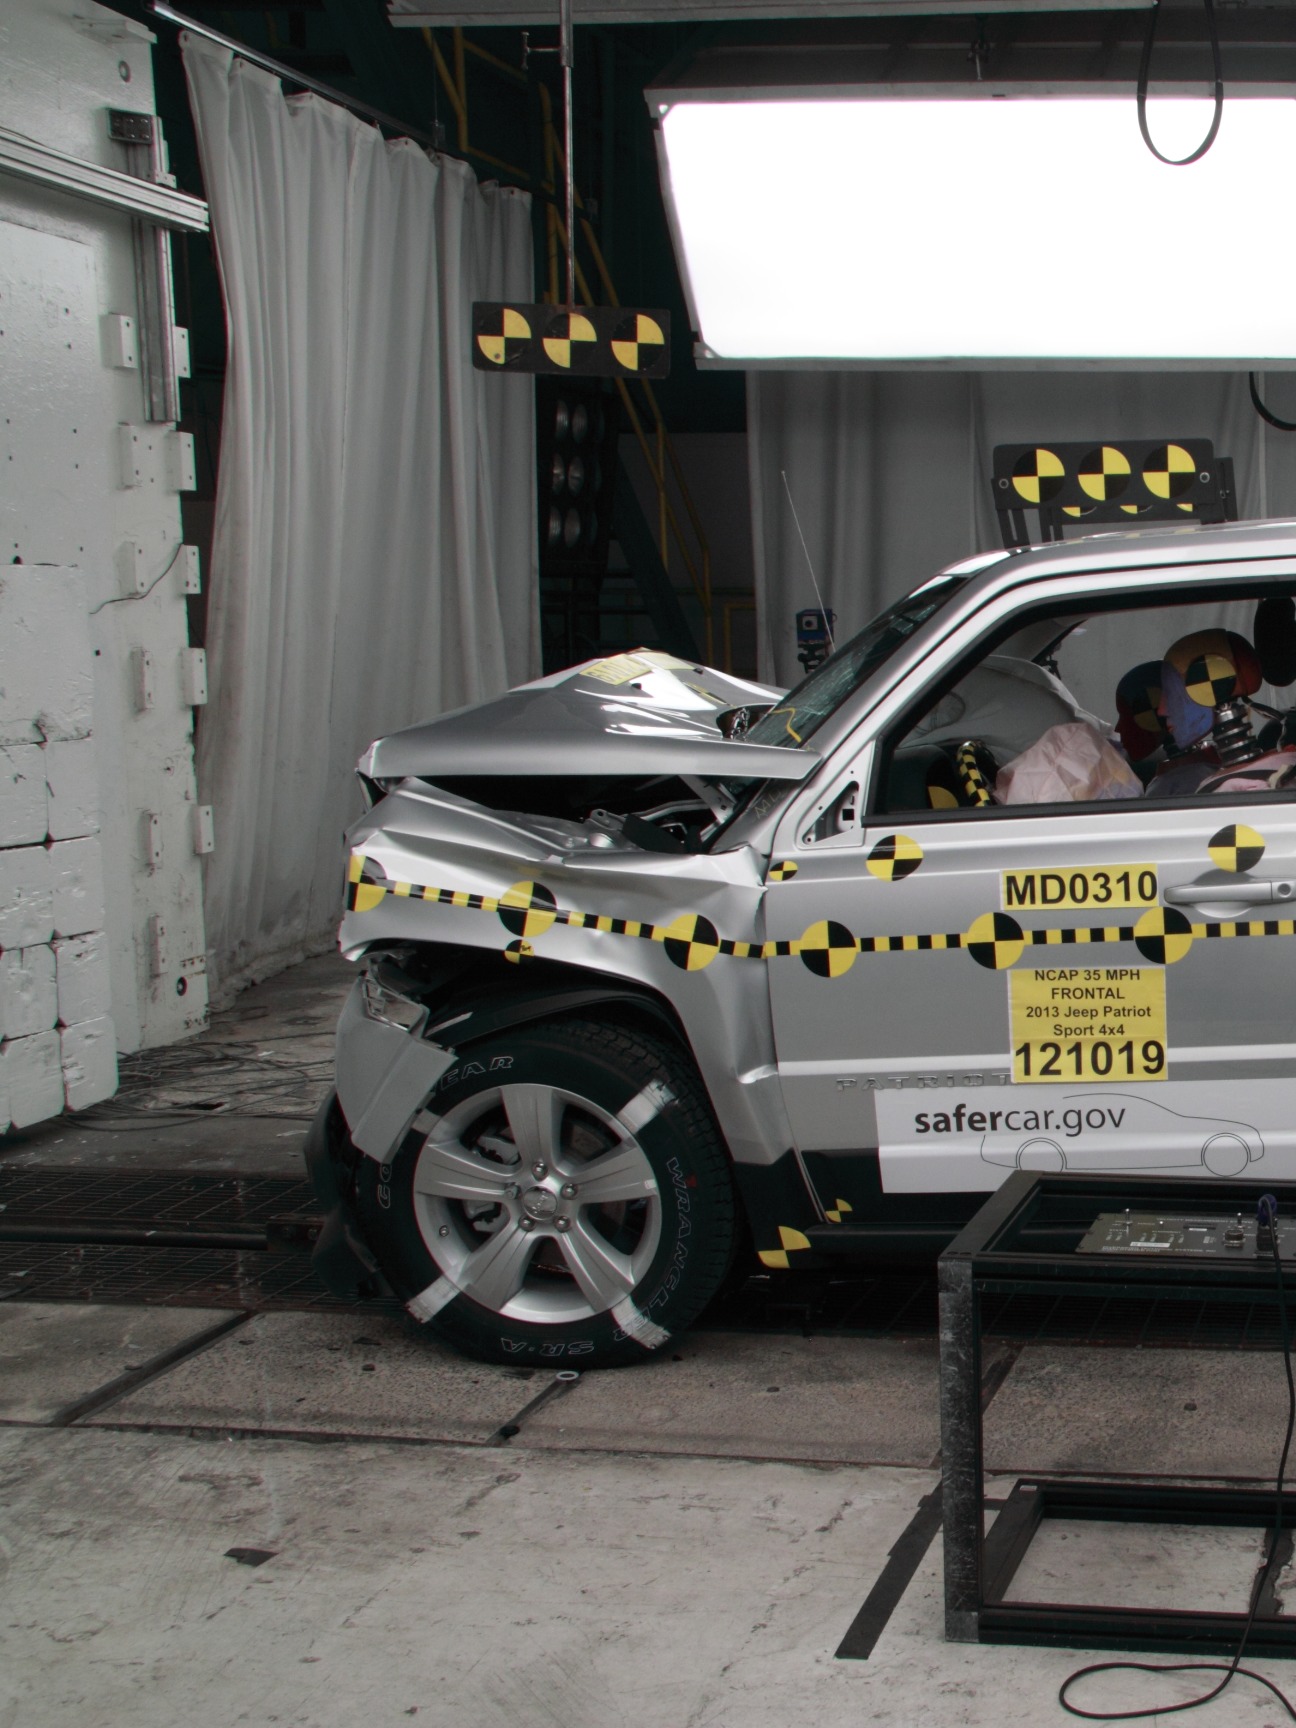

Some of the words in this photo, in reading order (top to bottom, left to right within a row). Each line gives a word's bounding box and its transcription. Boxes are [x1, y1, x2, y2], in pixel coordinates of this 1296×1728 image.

[1005, 870, 1158, 906] MD0310
[1034, 969, 1079, 981] NCAP
[1083, 969, 1101, 981] 35
[1106, 969, 1141, 981] MPH
[1051, 987, 1125, 1000] FRONTAL
[1026, 1006, 1060, 1018] 2013
[1064, 1006, 1099, 1020] Jeep
[1103, 1005, 1152, 1018] Patriot
[1053, 1024, 1094, 1038] Sport
[1099, 1024, 1125, 1036] 4x4
[1015, 1040, 1165, 1077] 121019
[836, 1073, 1011, 1091] PATRIOT
[914, 1103, 1126, 1138] safercar.gov
